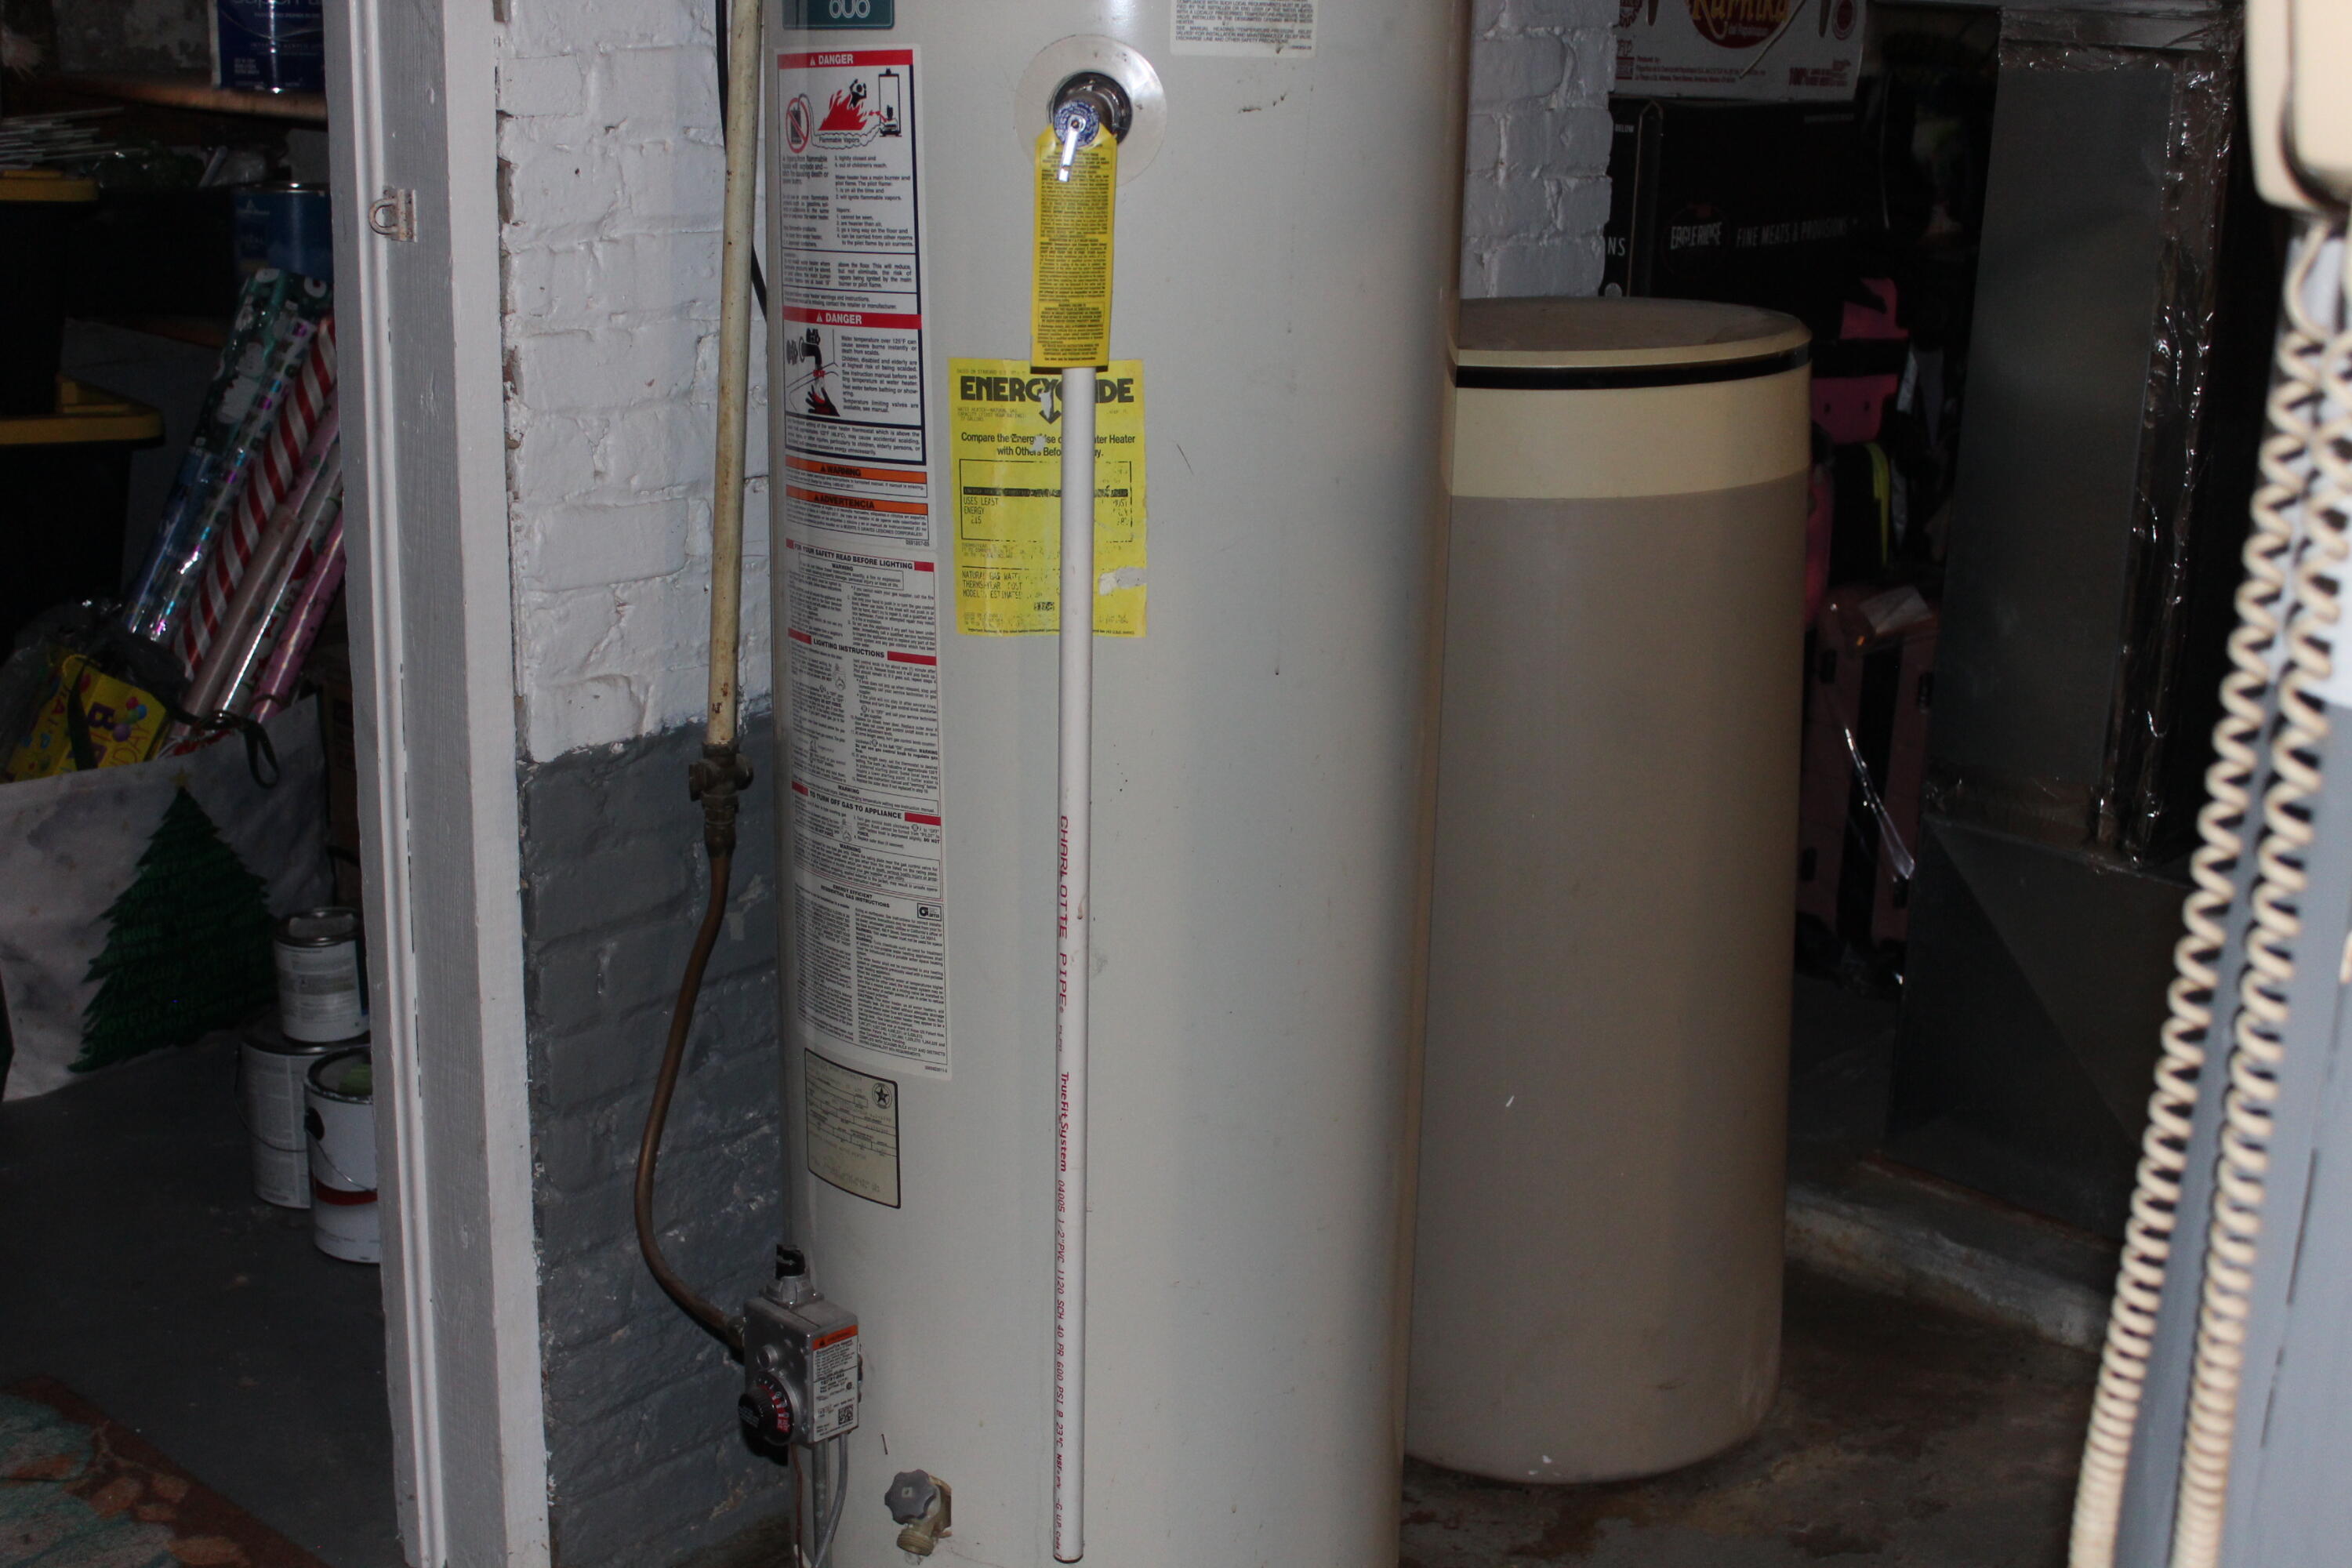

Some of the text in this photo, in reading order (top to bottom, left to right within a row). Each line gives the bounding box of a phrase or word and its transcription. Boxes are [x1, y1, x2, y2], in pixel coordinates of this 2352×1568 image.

[818, 54, 854, 65] DANGER
[1736, 227, 1759, 249] FINE
[1761, 223, 1791, 245] MEATS
[826, 313, 862, 325] DANGER
[961, 432, 996, 446] Compare
[997, 432, 1010, 443] the
[1109, 434, 1136, 444] Heater
[997, 447, 1014, 456] with
[1044, 447, 1062, 457] Befo
[826, 465, 862, 477] WARNING
[821, 495, 875, 510] ADVERTENCIA
[964, 497, 978, 506] USES
[964, 506, 985, 516] ENERGY
[803, 546, 815, 555] YOUR
[815, 549, 834, 560] SAFETY
[836, 554, 852, 563] READ
[852, 556, 877, 566] BEFORE
[879, 560, 913, 570] LIGHTING
[813, 639, 885, 659] LIGHTING INSTRUCTIONS
[838, 785, 860, 795] WARNING
[816, 793, 830, 804] TURN
[830, 797, 840, 806] OFF
[841, 801, 855, 811] GAS
[855, 804, 864, 813] TO
[865, 807, 902, 820] APPLIANCE
[840, 843, 862, 853] WARNING
[1059, 815, 1068, 939] CHARLOTTE
[1057, 1179, 1065, 1213] 04005
[1057, 1324, 1065, 1338] 40
[1057, 1342, 1065, 1357] PR
